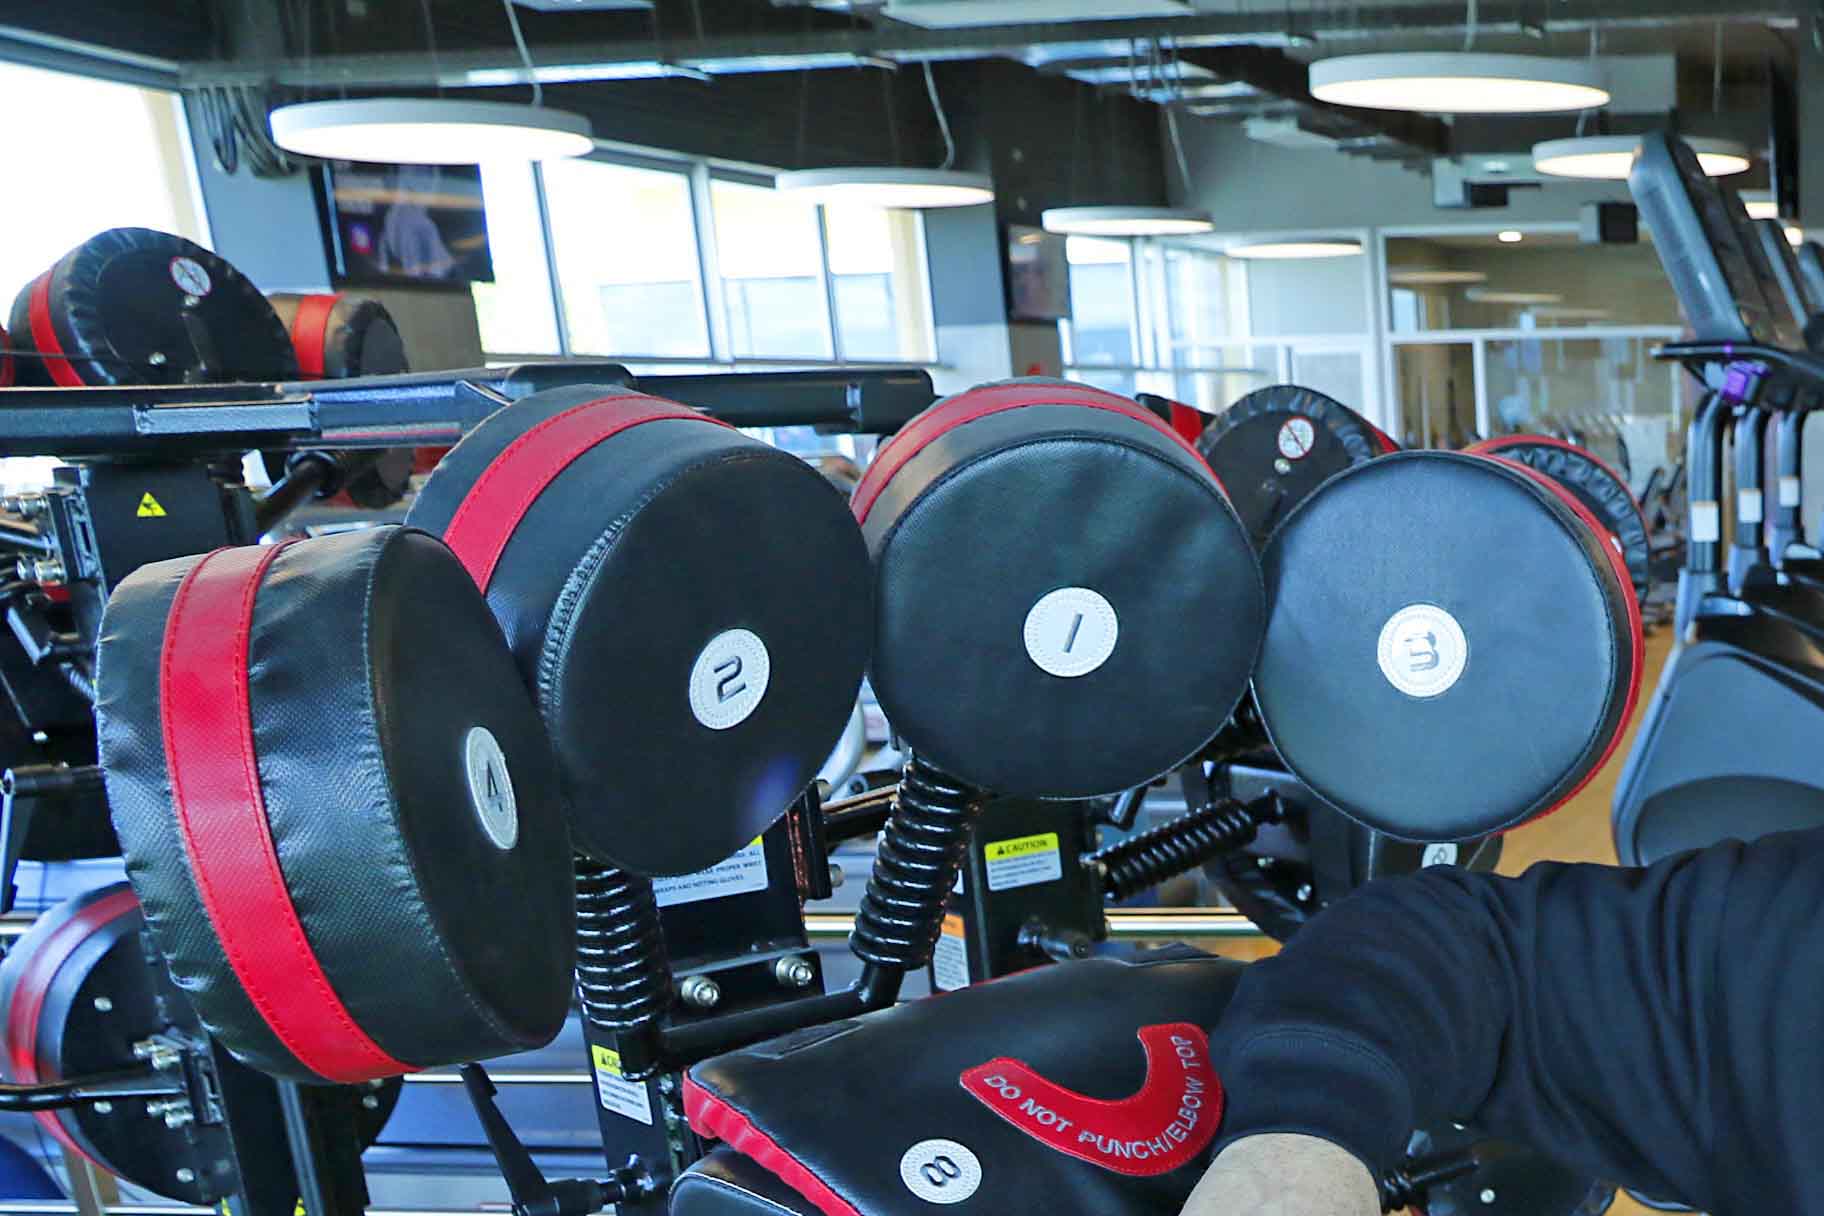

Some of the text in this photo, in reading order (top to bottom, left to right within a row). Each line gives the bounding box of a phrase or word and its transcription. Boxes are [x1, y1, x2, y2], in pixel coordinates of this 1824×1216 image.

[1063, 613, 1084, 653] 1
[1403, 631, 1440, 672] 3
[712, 655, 747, 704] 2
[486, 760, 504, 813] 4
[1006, 839, 1048, 854] CAUTION
[983, 1034, 1206, 1160] DO NOT PUNCH/ELBOW TOP
[920, 1155, 962, 1187] 8
